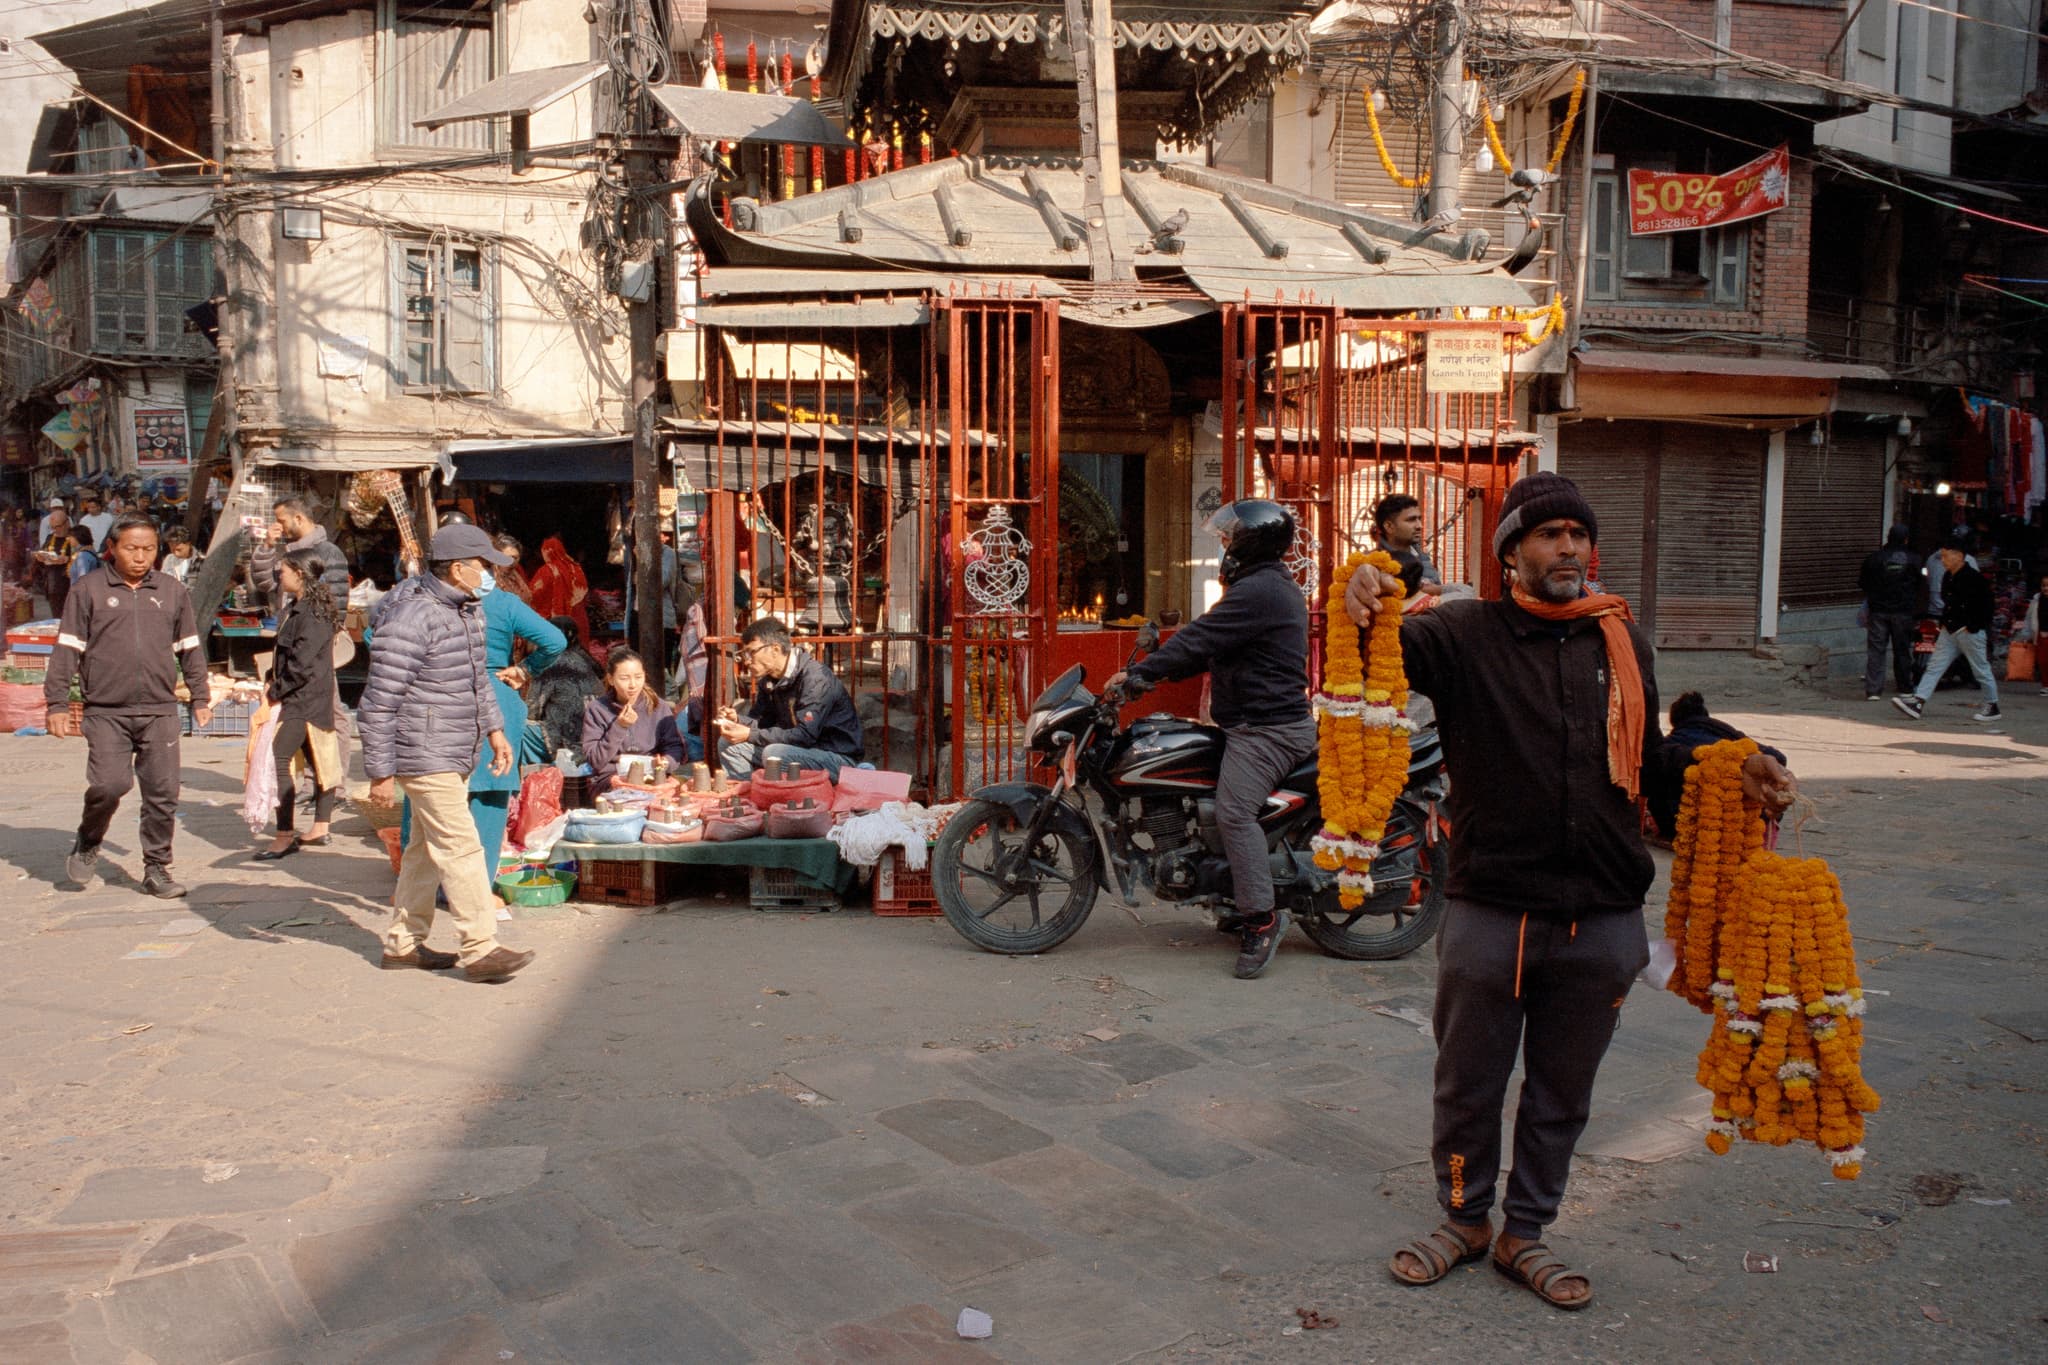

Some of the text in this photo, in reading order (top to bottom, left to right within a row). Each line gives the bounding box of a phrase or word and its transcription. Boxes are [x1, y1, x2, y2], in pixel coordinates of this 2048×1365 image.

[1637, 177, 1722, 215] 50%
[1637, 216, 1698, 230] 9813528166
[1432, 369, 1498, 378] Ganesh Temple
